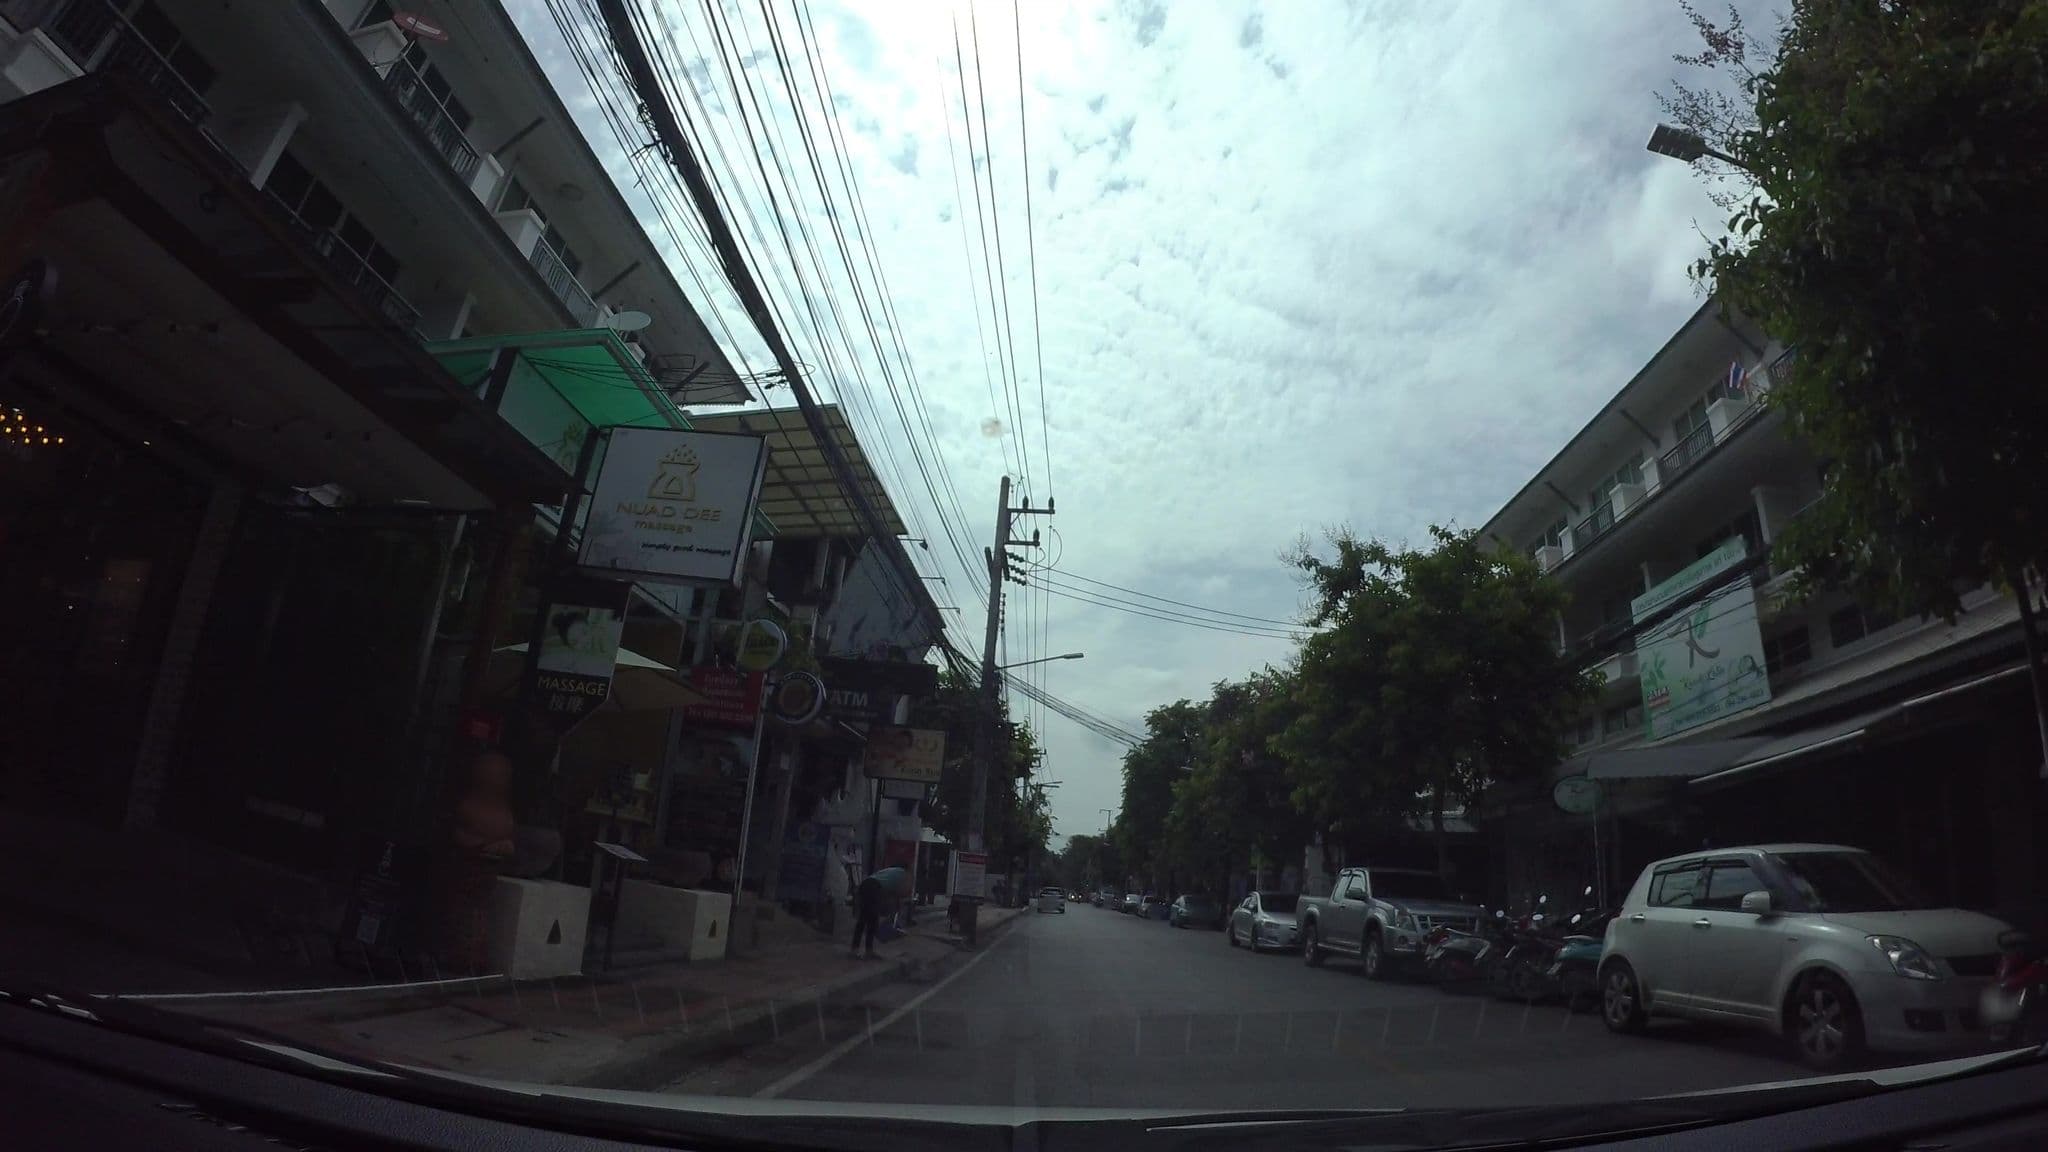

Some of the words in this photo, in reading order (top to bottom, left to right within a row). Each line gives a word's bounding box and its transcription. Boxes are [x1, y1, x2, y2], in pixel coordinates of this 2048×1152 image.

[616, 501, 675, 518] NUAD
[684, 506, 722, 522] DEE
[634, 520, 693, 534] massage
[537, 676, 606, 696] MASSAGE
[830, 690, 868, 707] ATM
